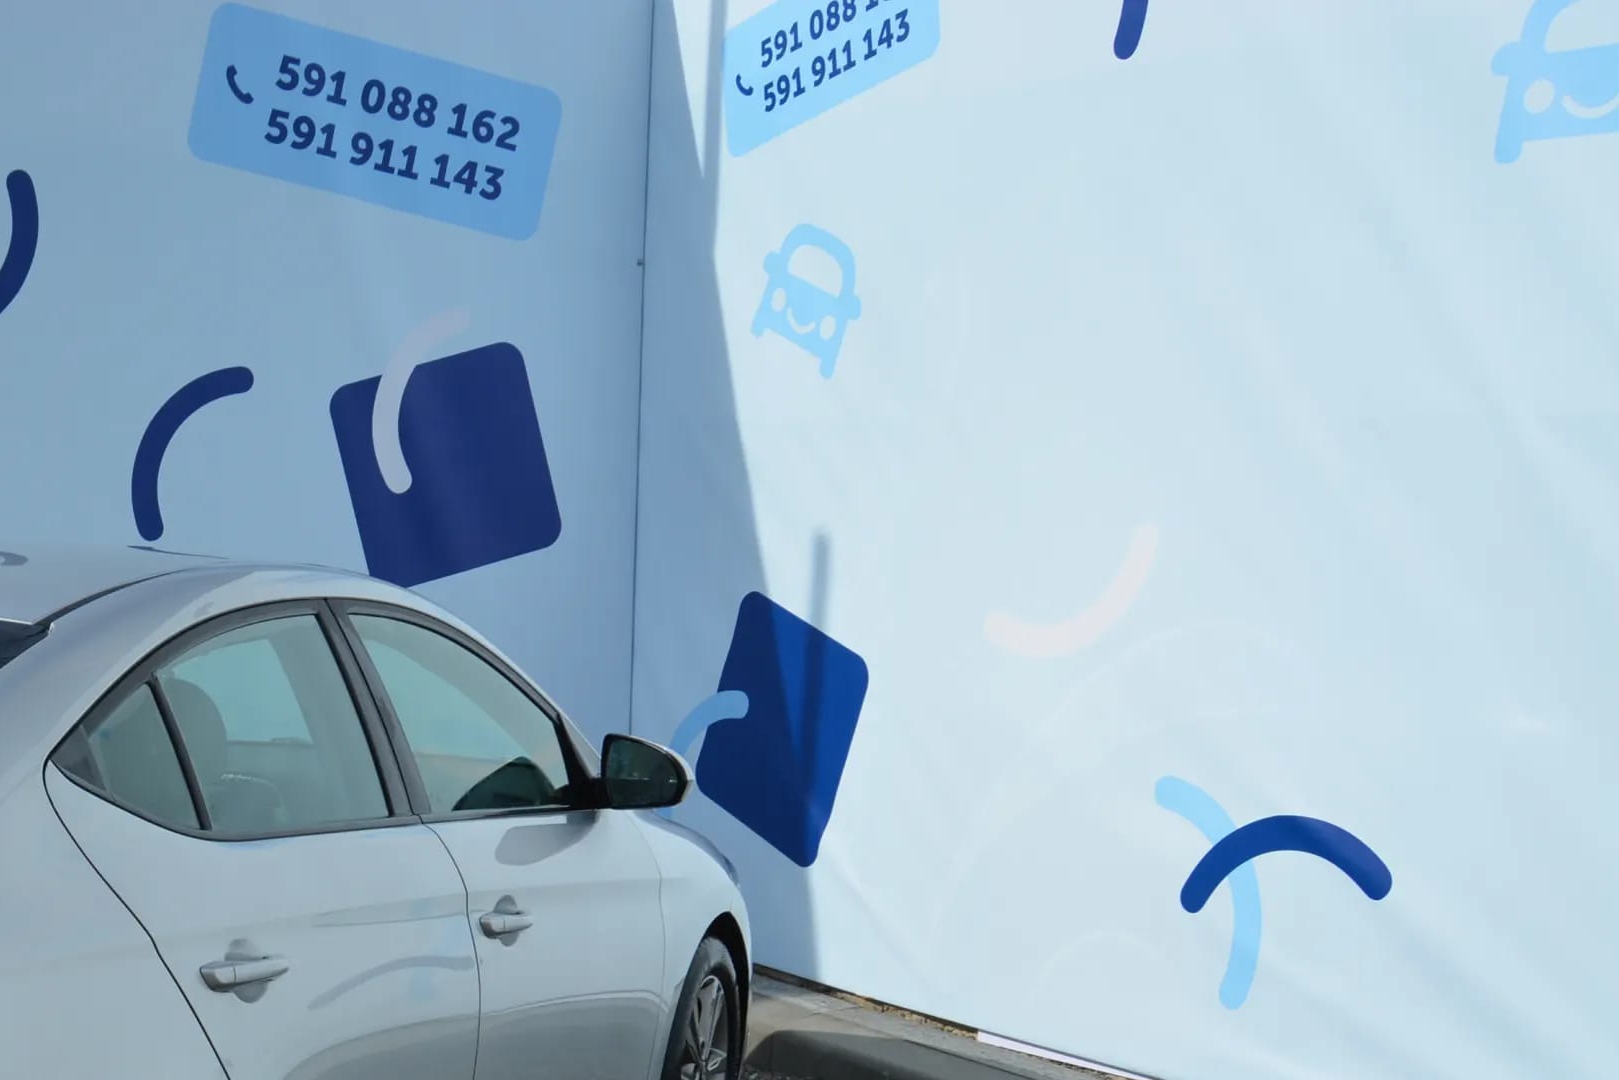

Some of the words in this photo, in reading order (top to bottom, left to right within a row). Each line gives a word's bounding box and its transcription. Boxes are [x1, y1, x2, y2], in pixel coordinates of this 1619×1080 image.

[761, 21, 802, 68] 591
[810, 0, 856, 40] 088
[763, 67, 805, 112] 591
[811, 40, 856, 87] 911
[863, 8, 910, 61] 143
[275, 54, 347, 106] 591
[361, 79, 438, 128] 088
[447, 103, 520, 151] 162
[264, 109, 337, 158] 591
[349, 132, 419, 180] 911
[430, 153, 505, 200] 143
